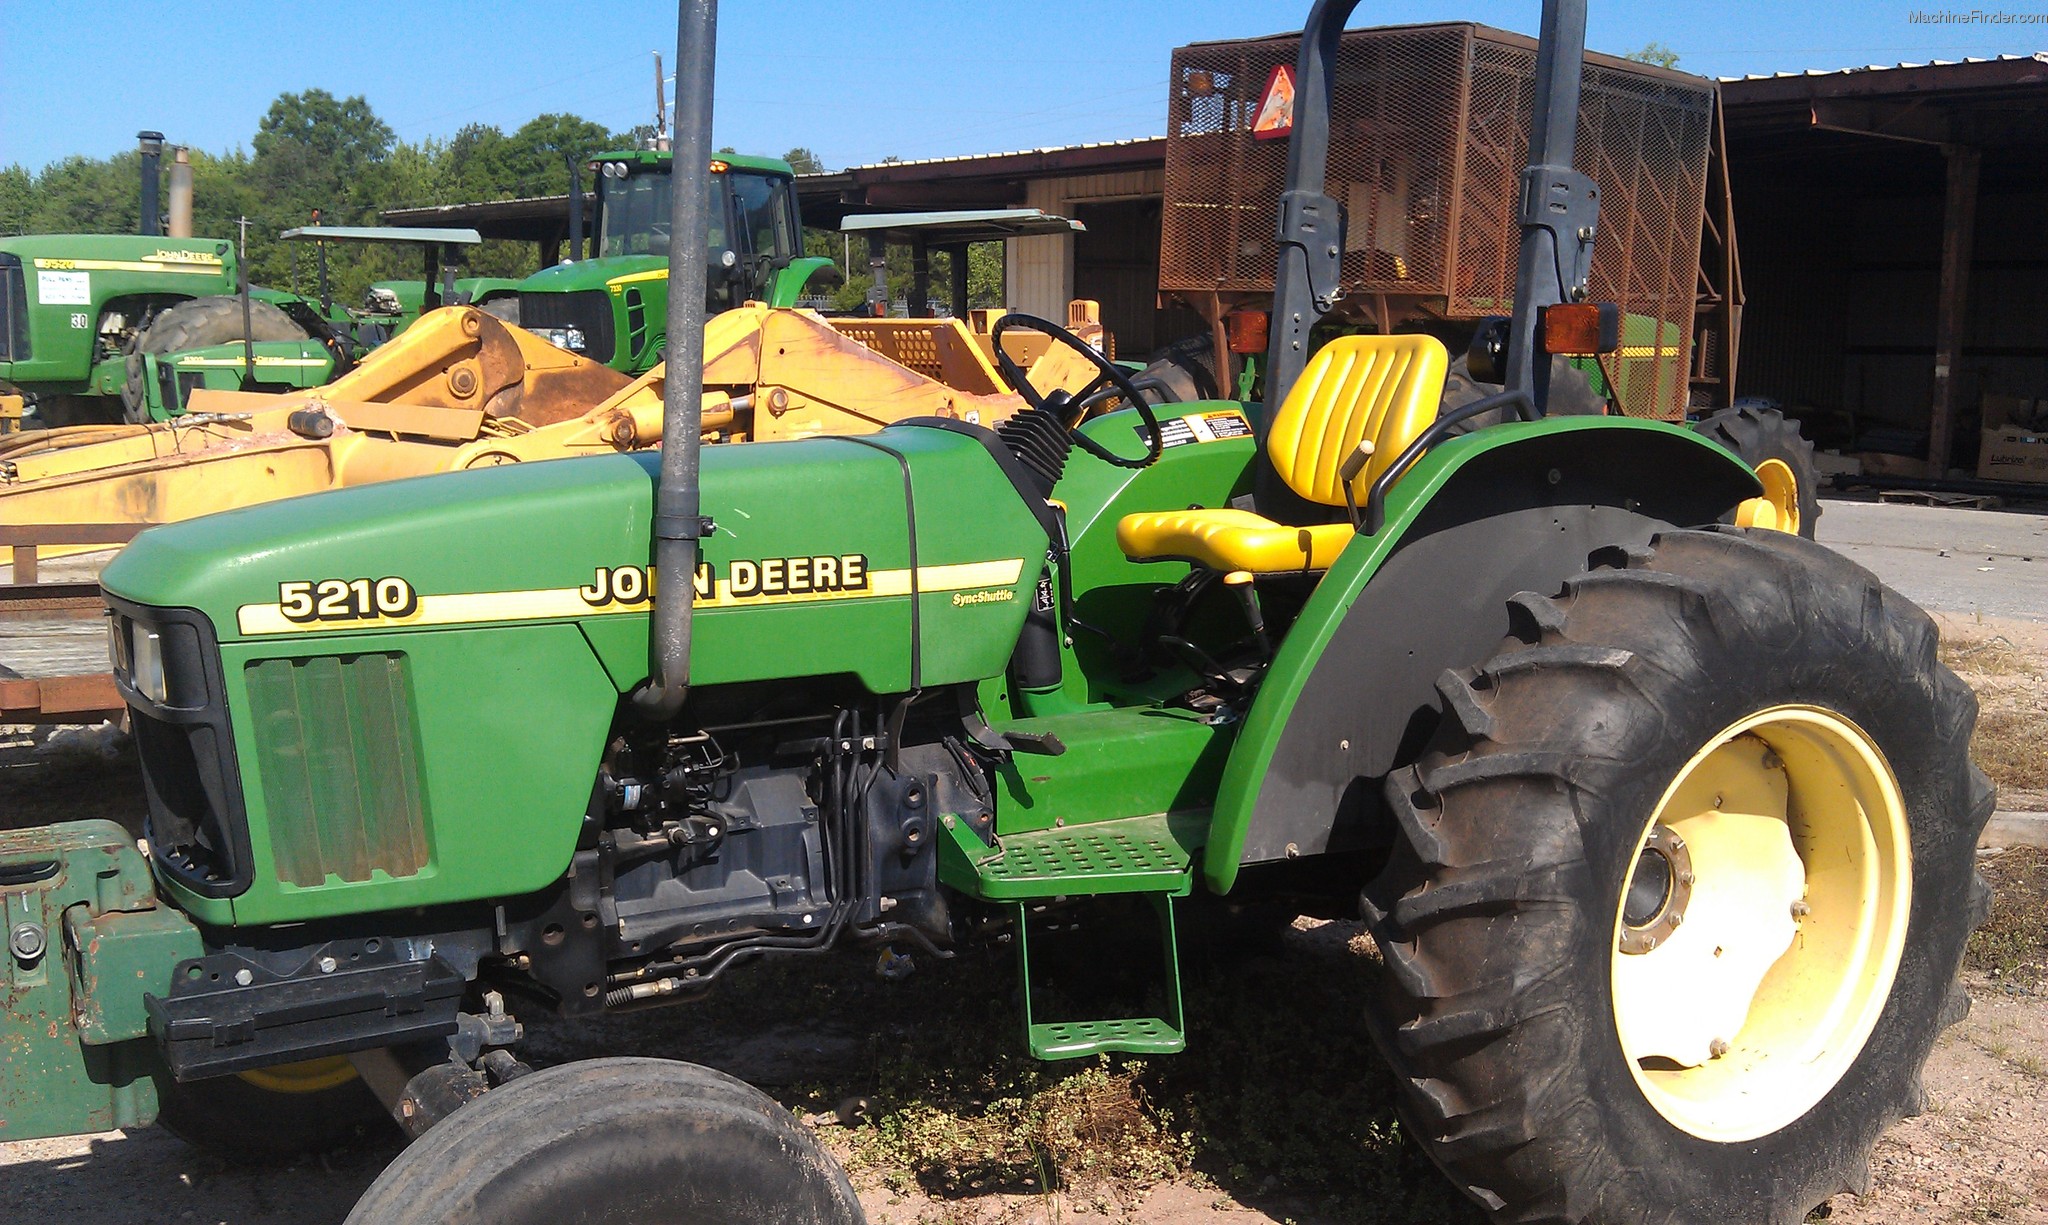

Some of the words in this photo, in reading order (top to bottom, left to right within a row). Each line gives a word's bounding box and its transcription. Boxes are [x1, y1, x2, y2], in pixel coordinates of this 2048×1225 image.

[156, 249, 183, 260] JOHN
[182, 250, 214, 261] DEERE
[71, 314, 87, 328] 30
[729, 553, 868, 598] DEERE
[278, 576, 418, 624] 5210
